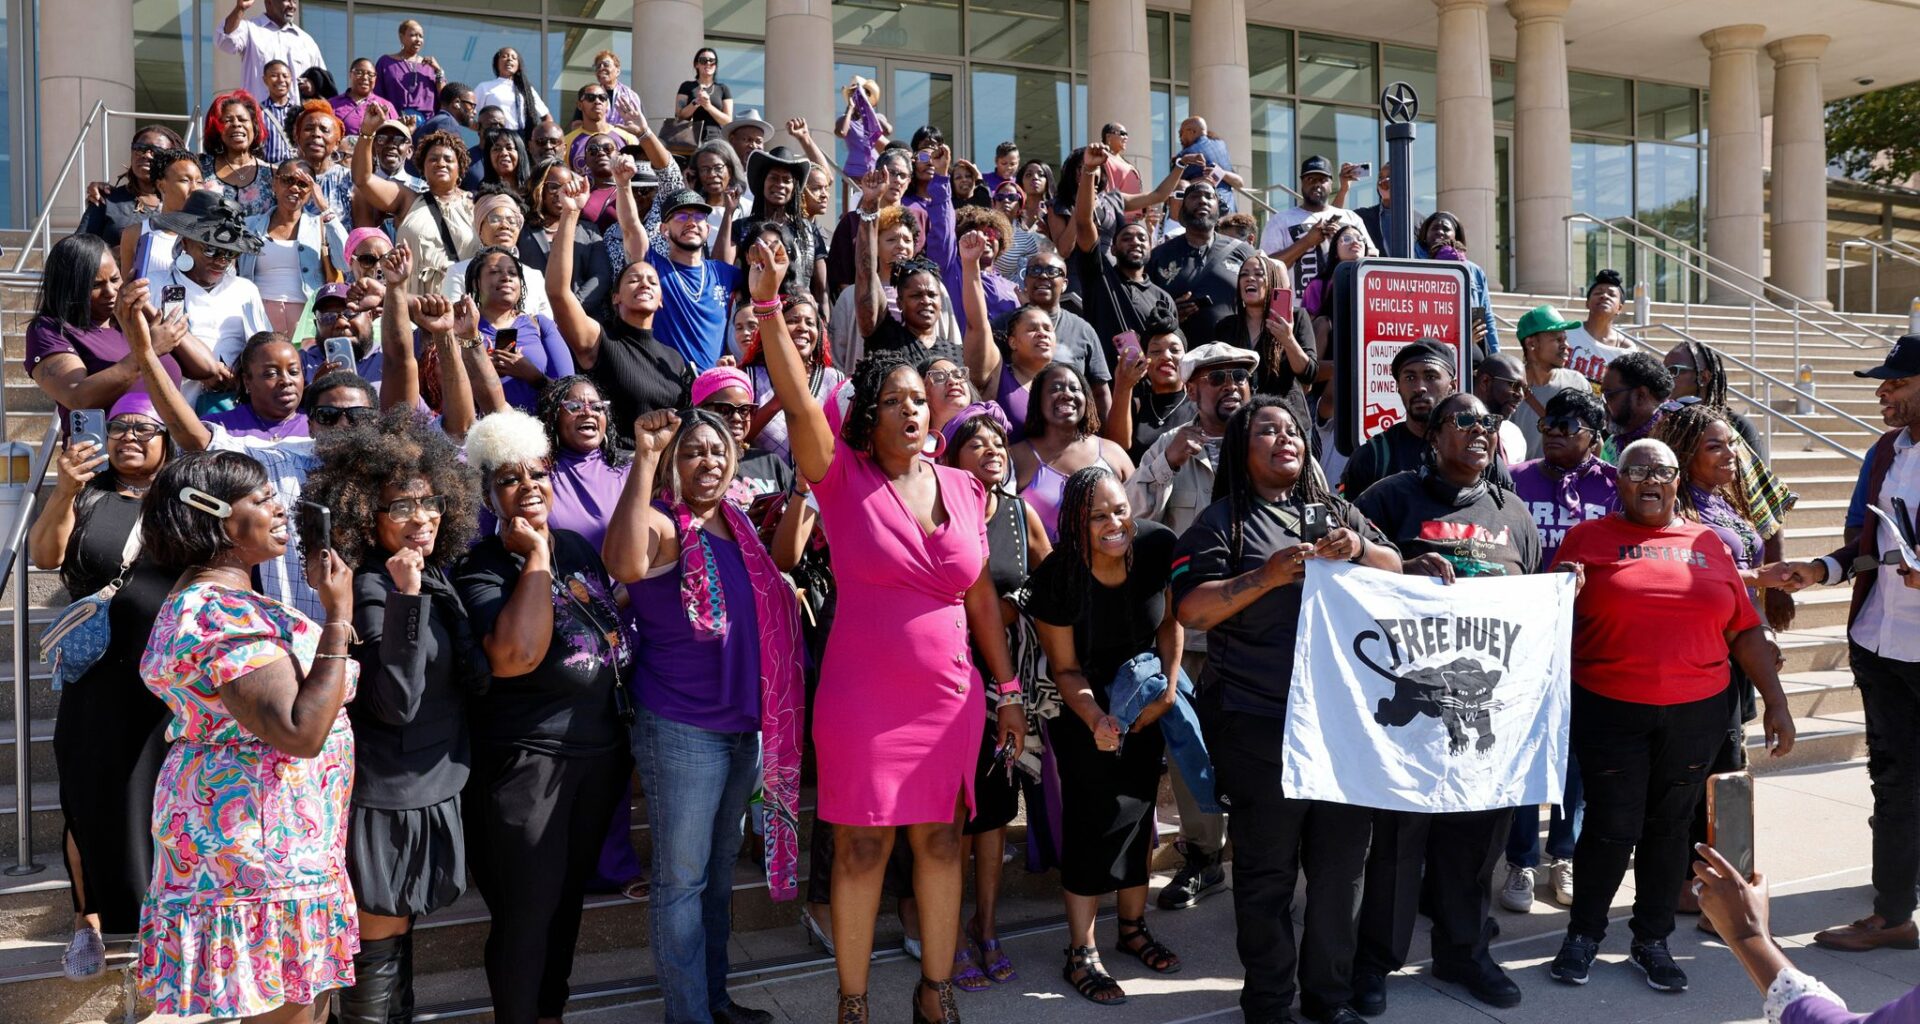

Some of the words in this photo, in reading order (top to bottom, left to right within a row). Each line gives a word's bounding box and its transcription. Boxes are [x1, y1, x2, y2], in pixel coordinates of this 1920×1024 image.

[1368, 277, 1381, 290] NO
[1387, 278, 1457, 295] UNAUTHORIZED
[1369, 298, 1413, 313] VEHICLES
[1418, 301, 1428, 314] IN
[1434, 301, 1454, 315] THIS
[1377, 322, 1449, 337] DRIVE-WAY
[1372, 363, 1393, 376] TOWE
[1526, 501, 1606, 525] REE
[1616, 544, 1710, 569] JUSTICE
[1374, 616, 1451, 670] FREE
[1456, 616, 1522, 673] HUEY
